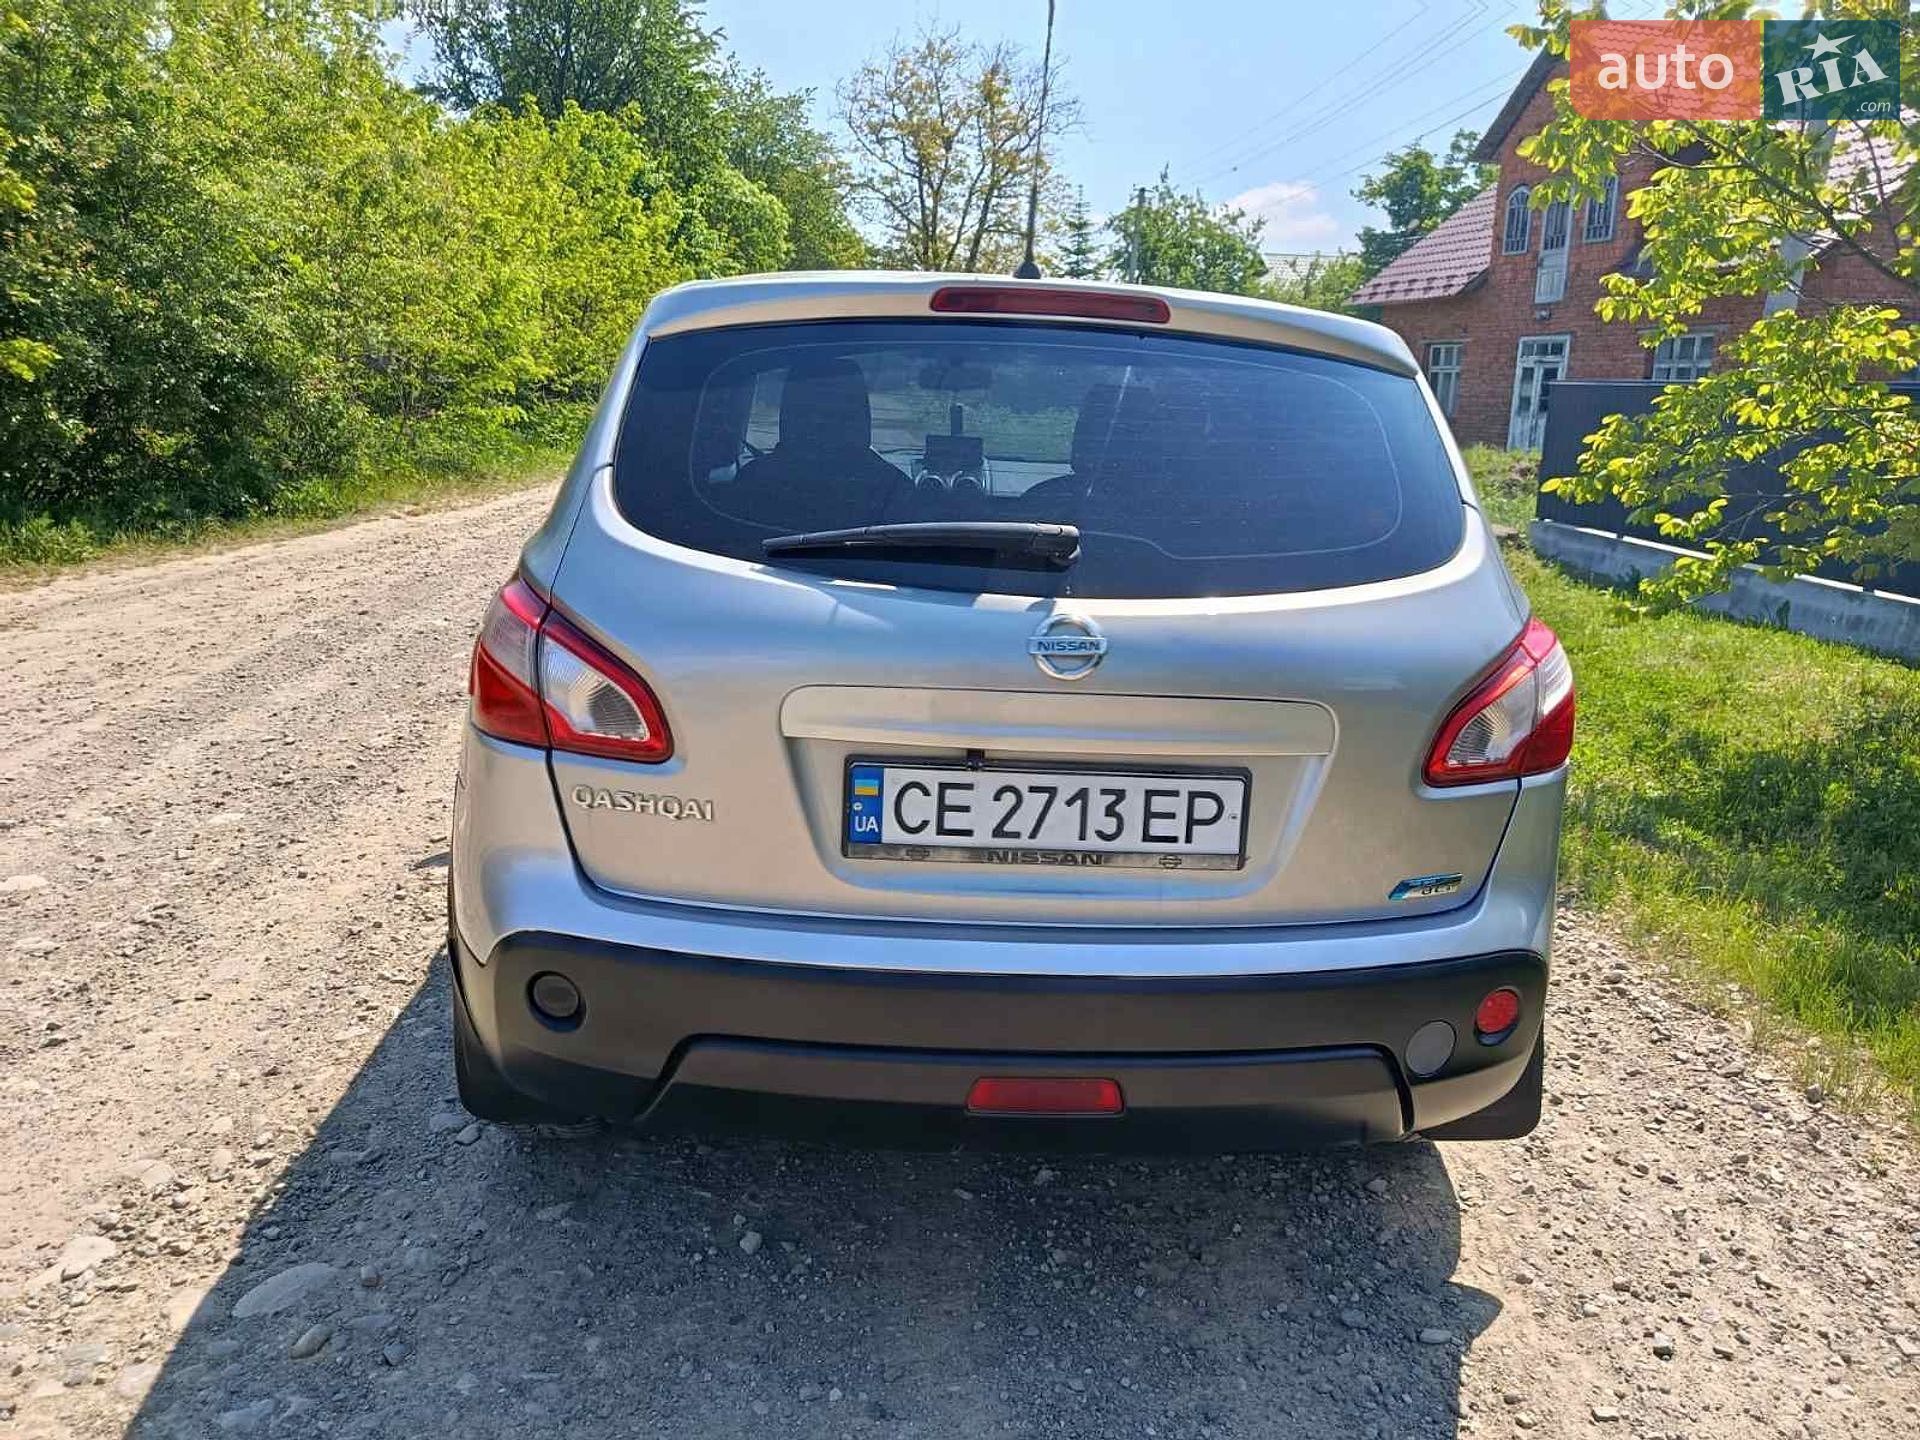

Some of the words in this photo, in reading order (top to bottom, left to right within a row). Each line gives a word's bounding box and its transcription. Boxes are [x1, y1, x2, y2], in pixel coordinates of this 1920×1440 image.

[1037, 641, 1100, 651] NISSAN
[572, 784, 713, 821] QASHQAI
[894, 781, 975, 836] CE
[992, 785, 1127, 843] 2713
[1142, 789, 1225, 844] EP
[854, 817, 879, 833] UA
[986, 849, 1103, 866] NISSAN
